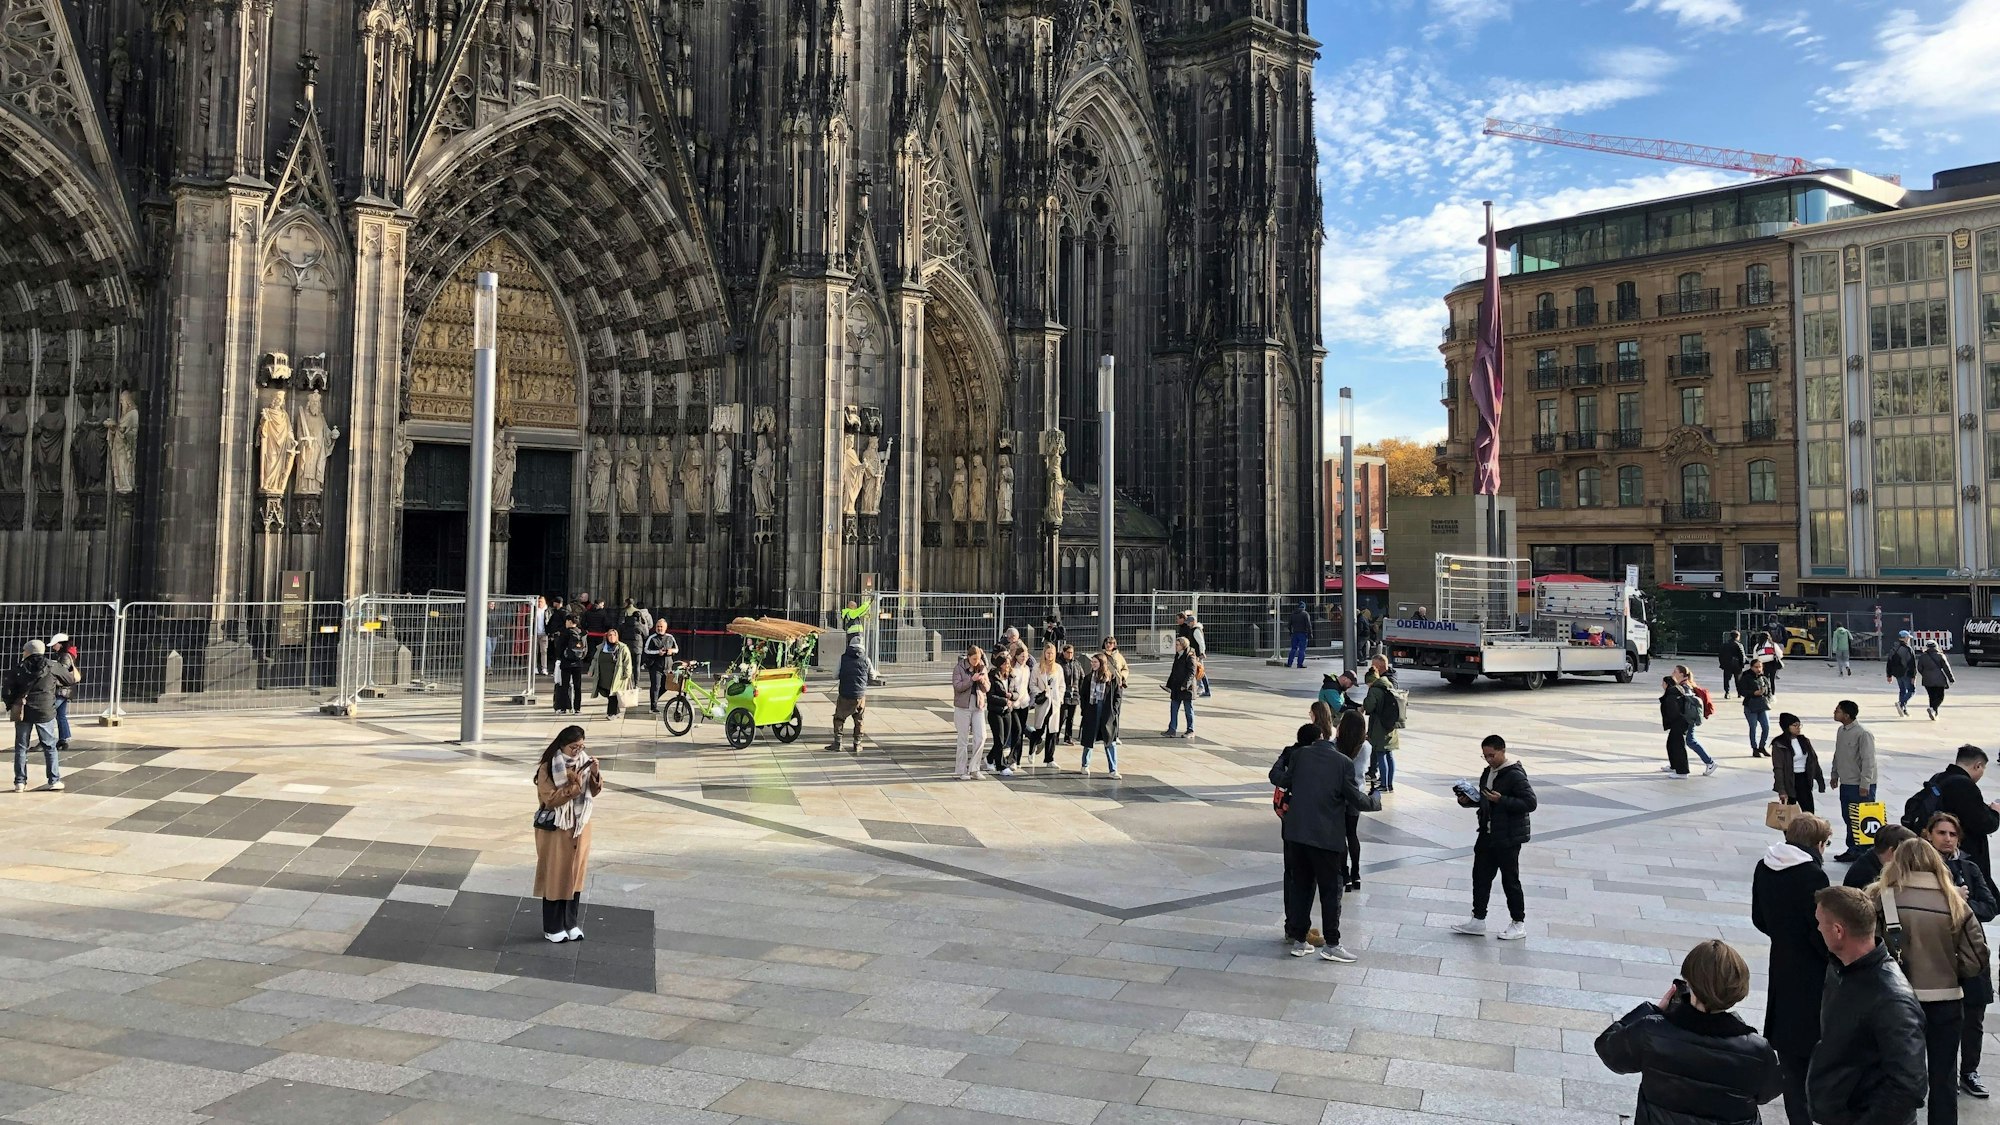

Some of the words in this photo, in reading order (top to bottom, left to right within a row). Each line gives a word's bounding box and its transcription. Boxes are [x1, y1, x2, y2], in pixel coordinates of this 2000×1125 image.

[1396, 619, 1459, 631] ODENDAHL
[1966, 619, 2000, 634] heimlic
[1864, 820, 1881, 834] JD
